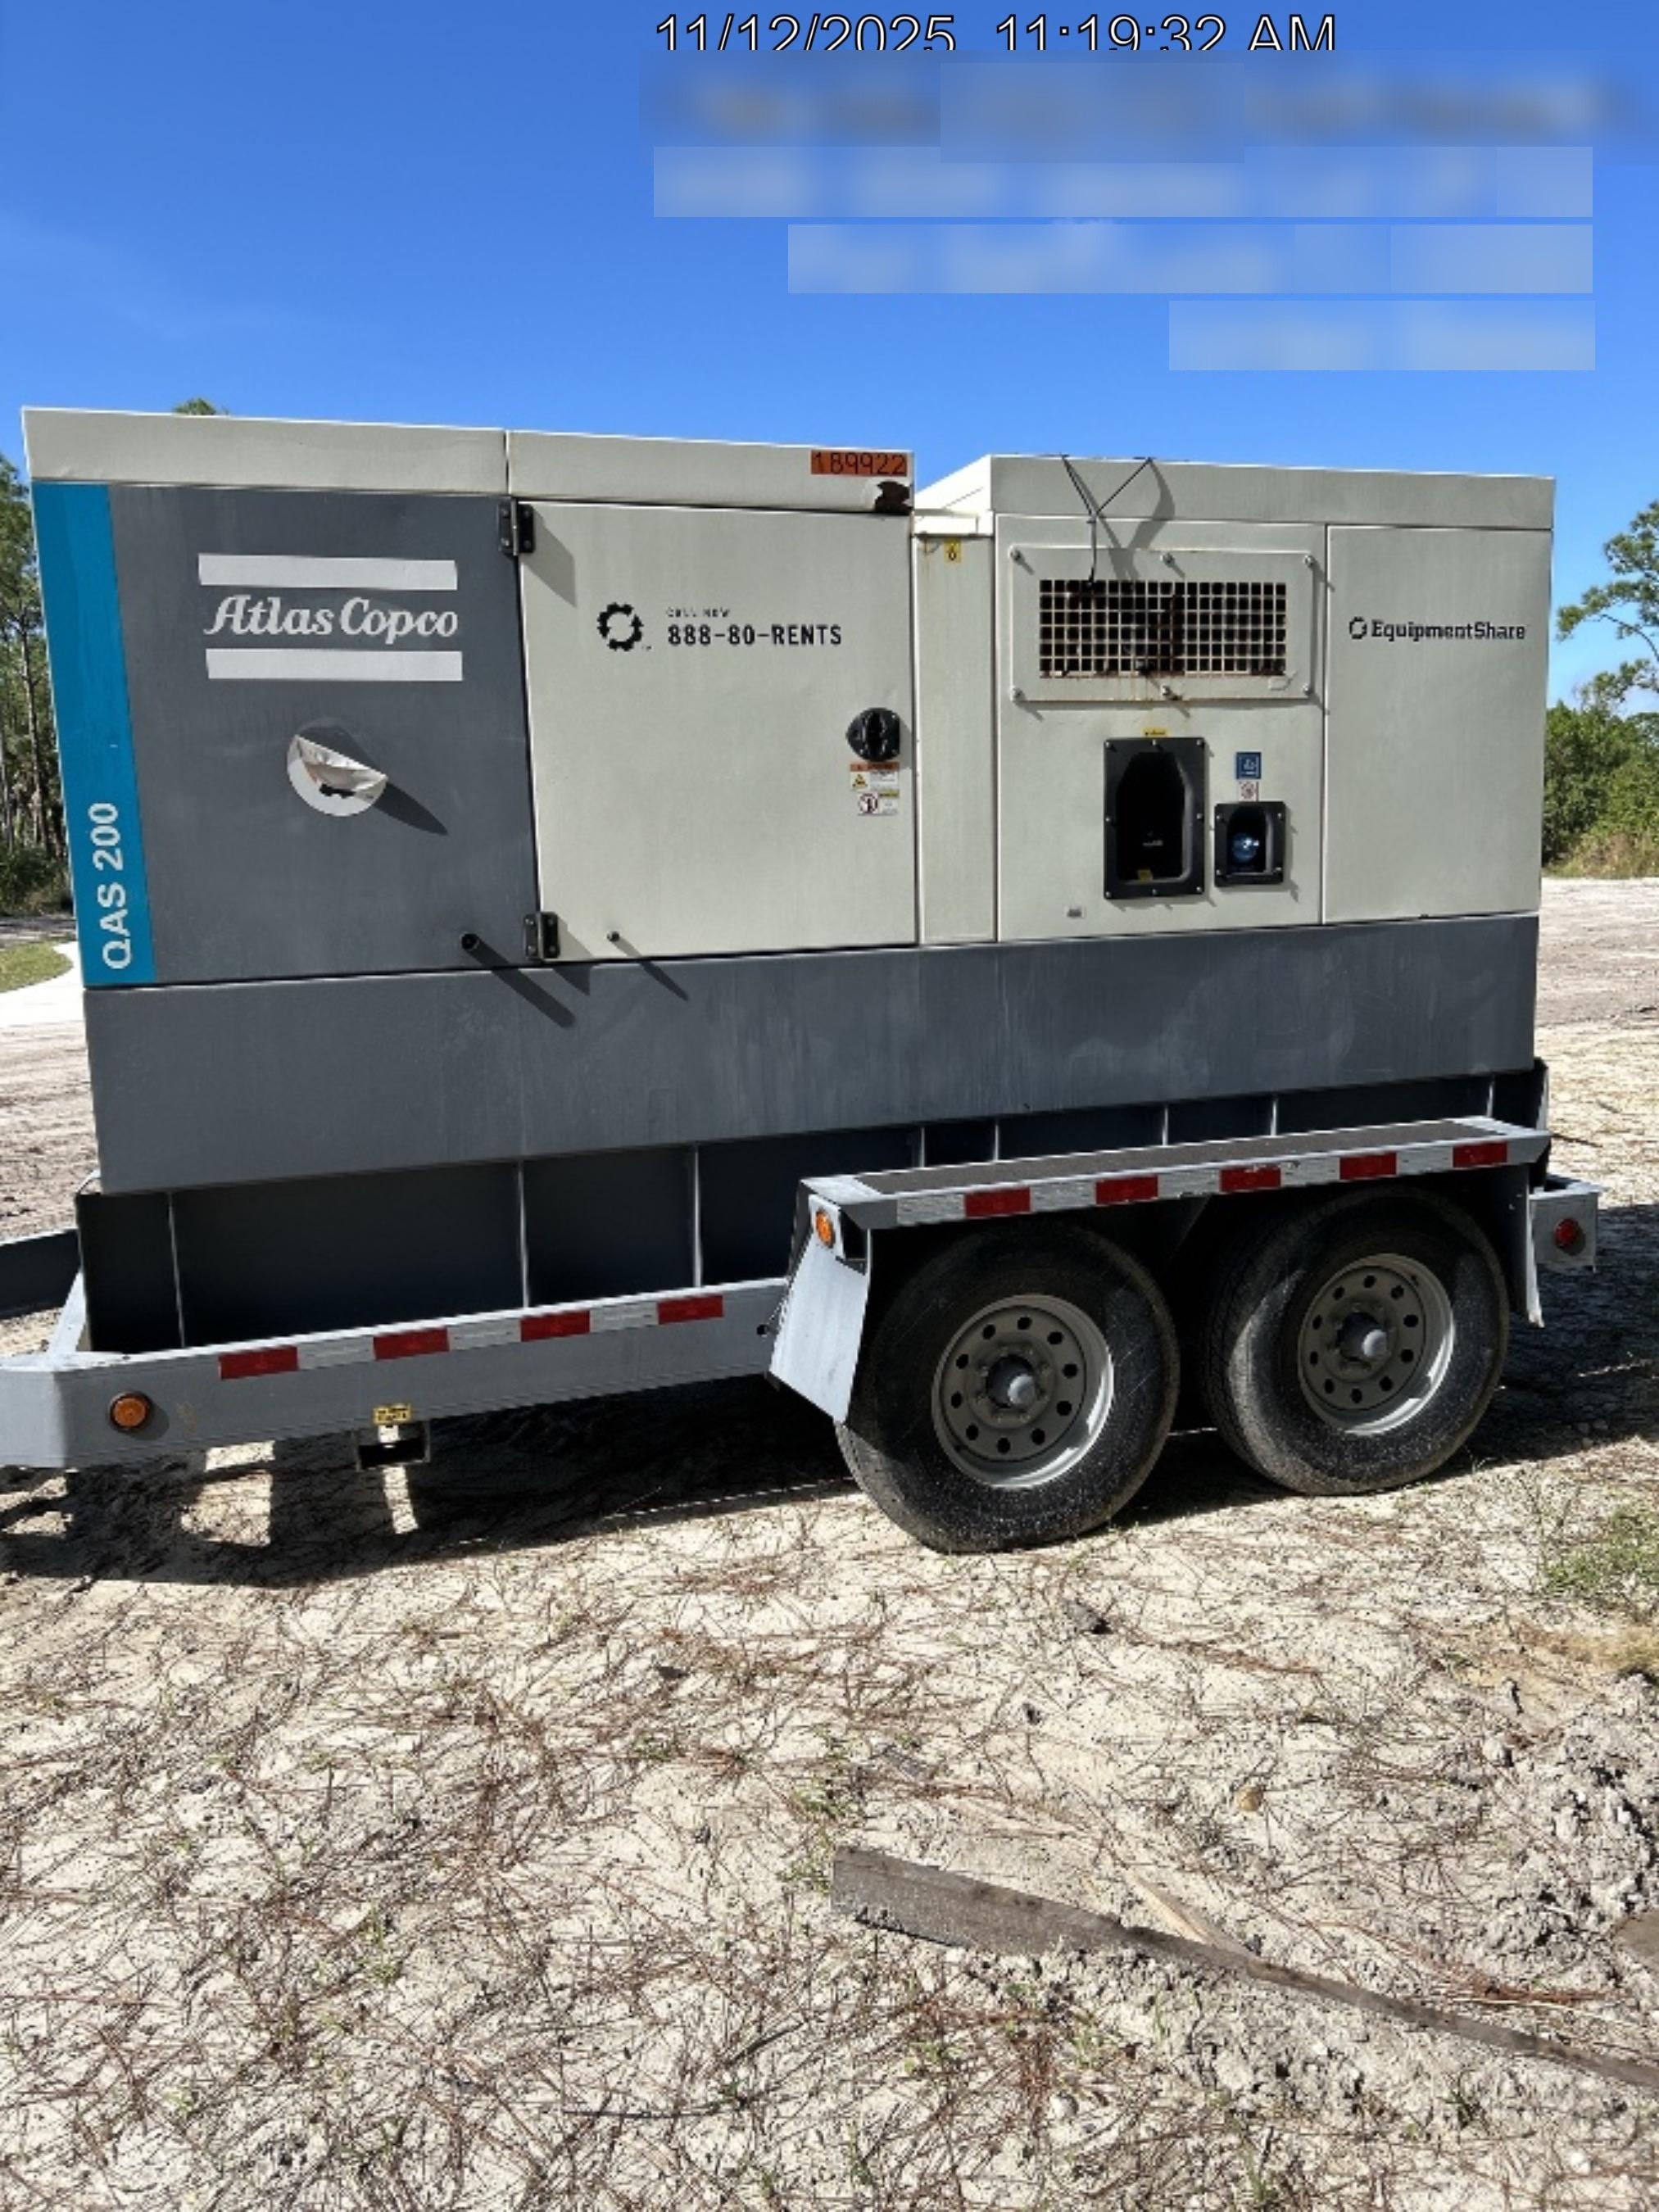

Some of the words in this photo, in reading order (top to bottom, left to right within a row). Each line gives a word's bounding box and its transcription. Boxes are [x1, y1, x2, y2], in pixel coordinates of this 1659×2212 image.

[814, 451, 907, 474] 189922
[203, 594, 334, 635] Atlas
[339, 596, 458, 645] Copco
[667, 623, 842, 646] 888-80-RENTS
[1371, 619, 1526, 641] EquipmentShare
[87, 802, 124, 872] 200
[94, 882, 132, 970] QAS
